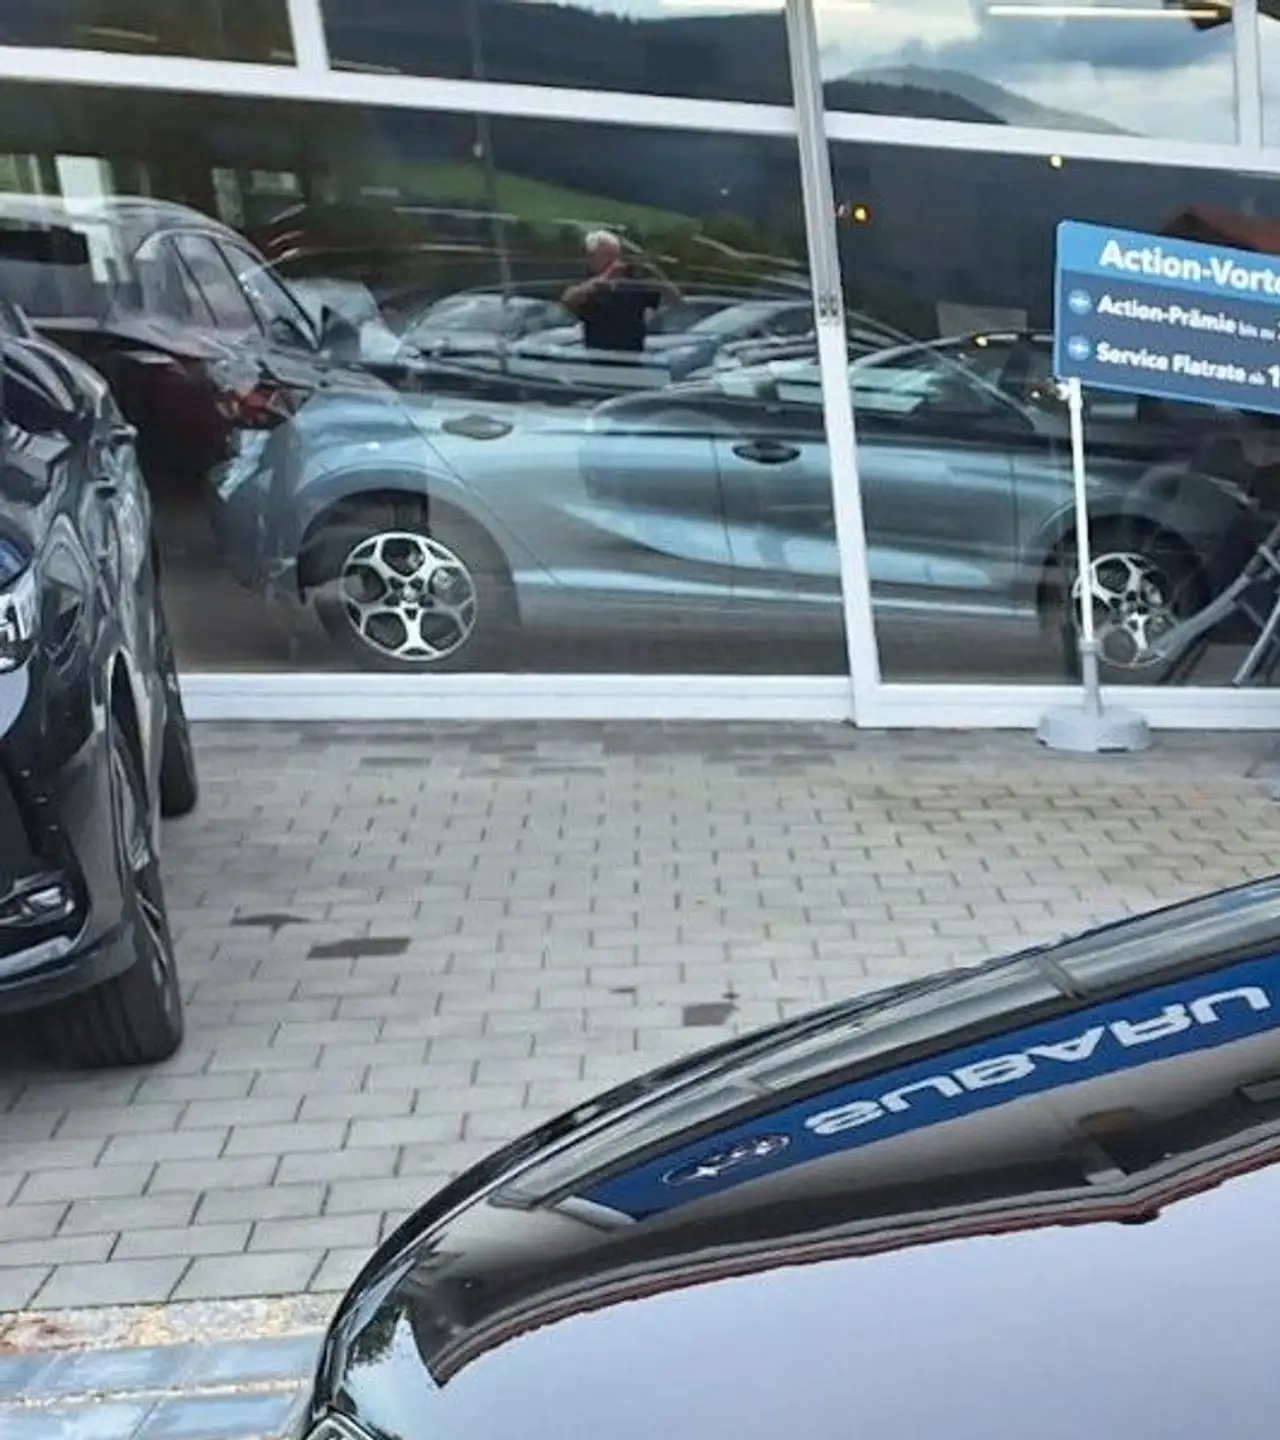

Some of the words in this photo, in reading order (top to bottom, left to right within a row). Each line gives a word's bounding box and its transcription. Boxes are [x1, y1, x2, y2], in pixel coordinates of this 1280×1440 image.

[1097, 295, 1237, 334] Action-Prämie
[1097, 341, 1169, 371] Service
[1173, 354, 1246, 384] Flatrate
